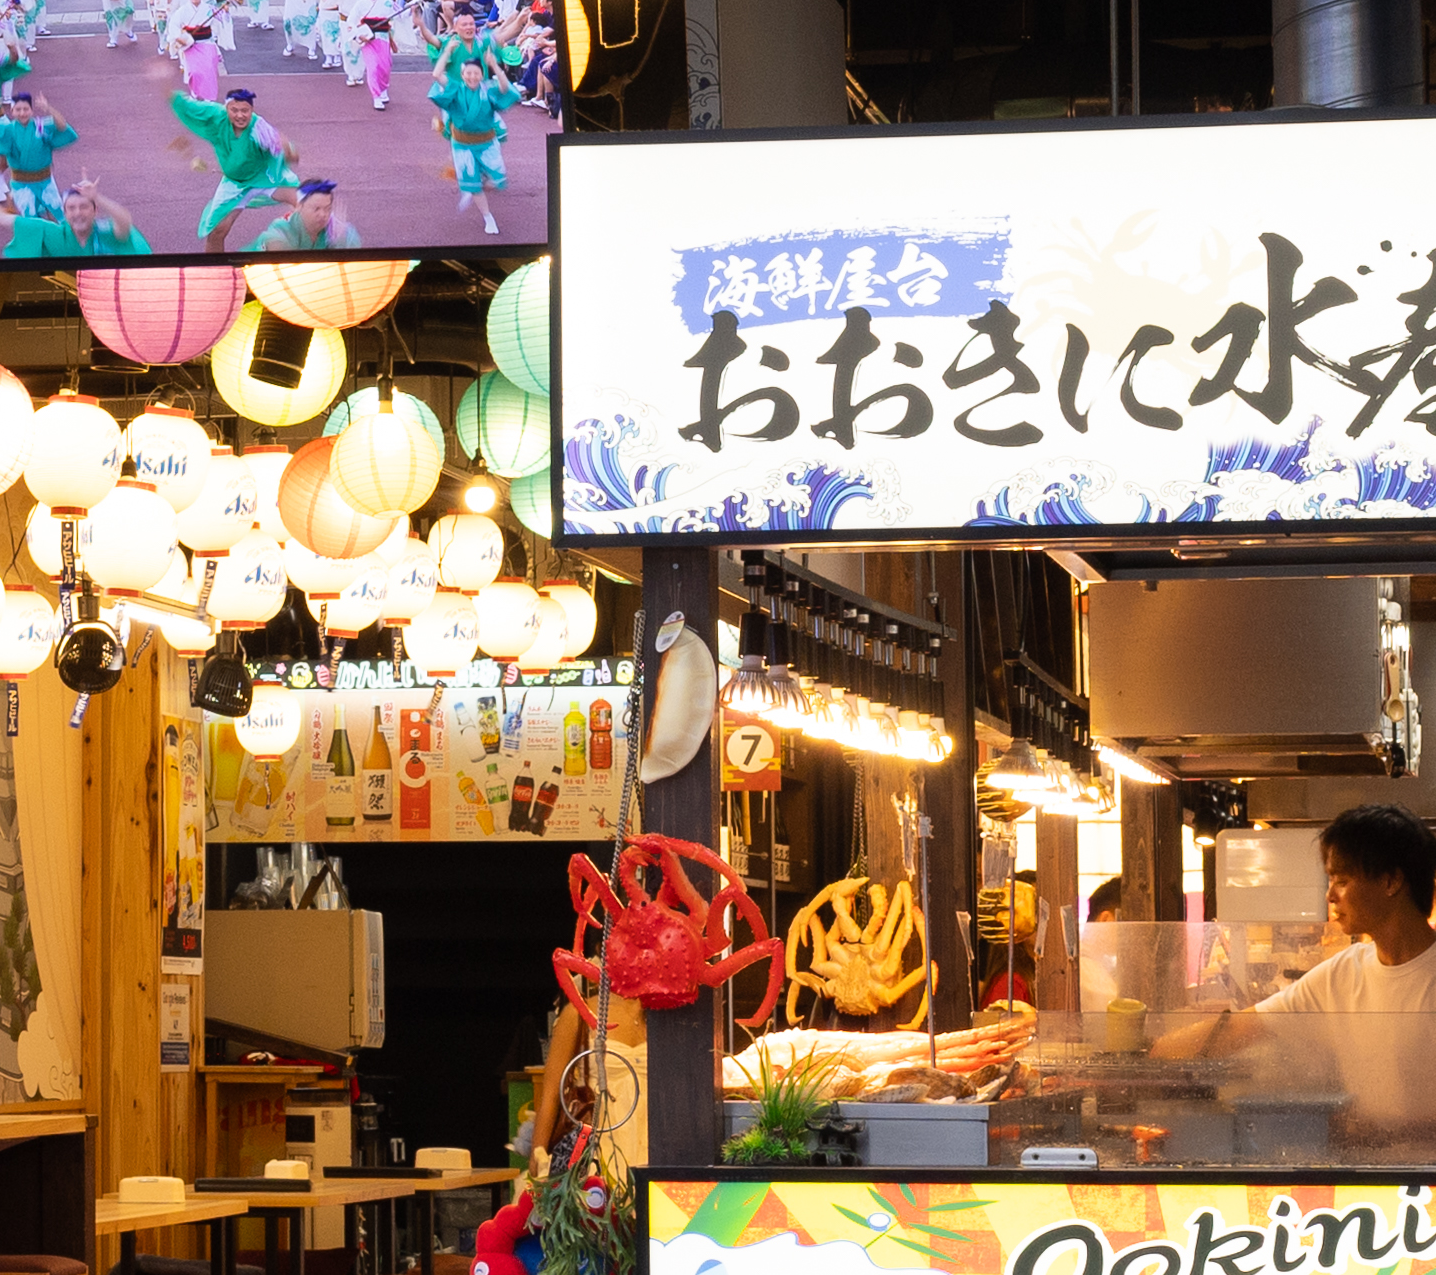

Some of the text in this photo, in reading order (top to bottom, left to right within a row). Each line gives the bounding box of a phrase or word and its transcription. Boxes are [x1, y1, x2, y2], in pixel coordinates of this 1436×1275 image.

[702, 242, 949, 318] 海鮮屋台
[240, 712, 285, 730] Asahi
[410, 739, 422, 765] まる
[741, 734, 762, 767] 7
